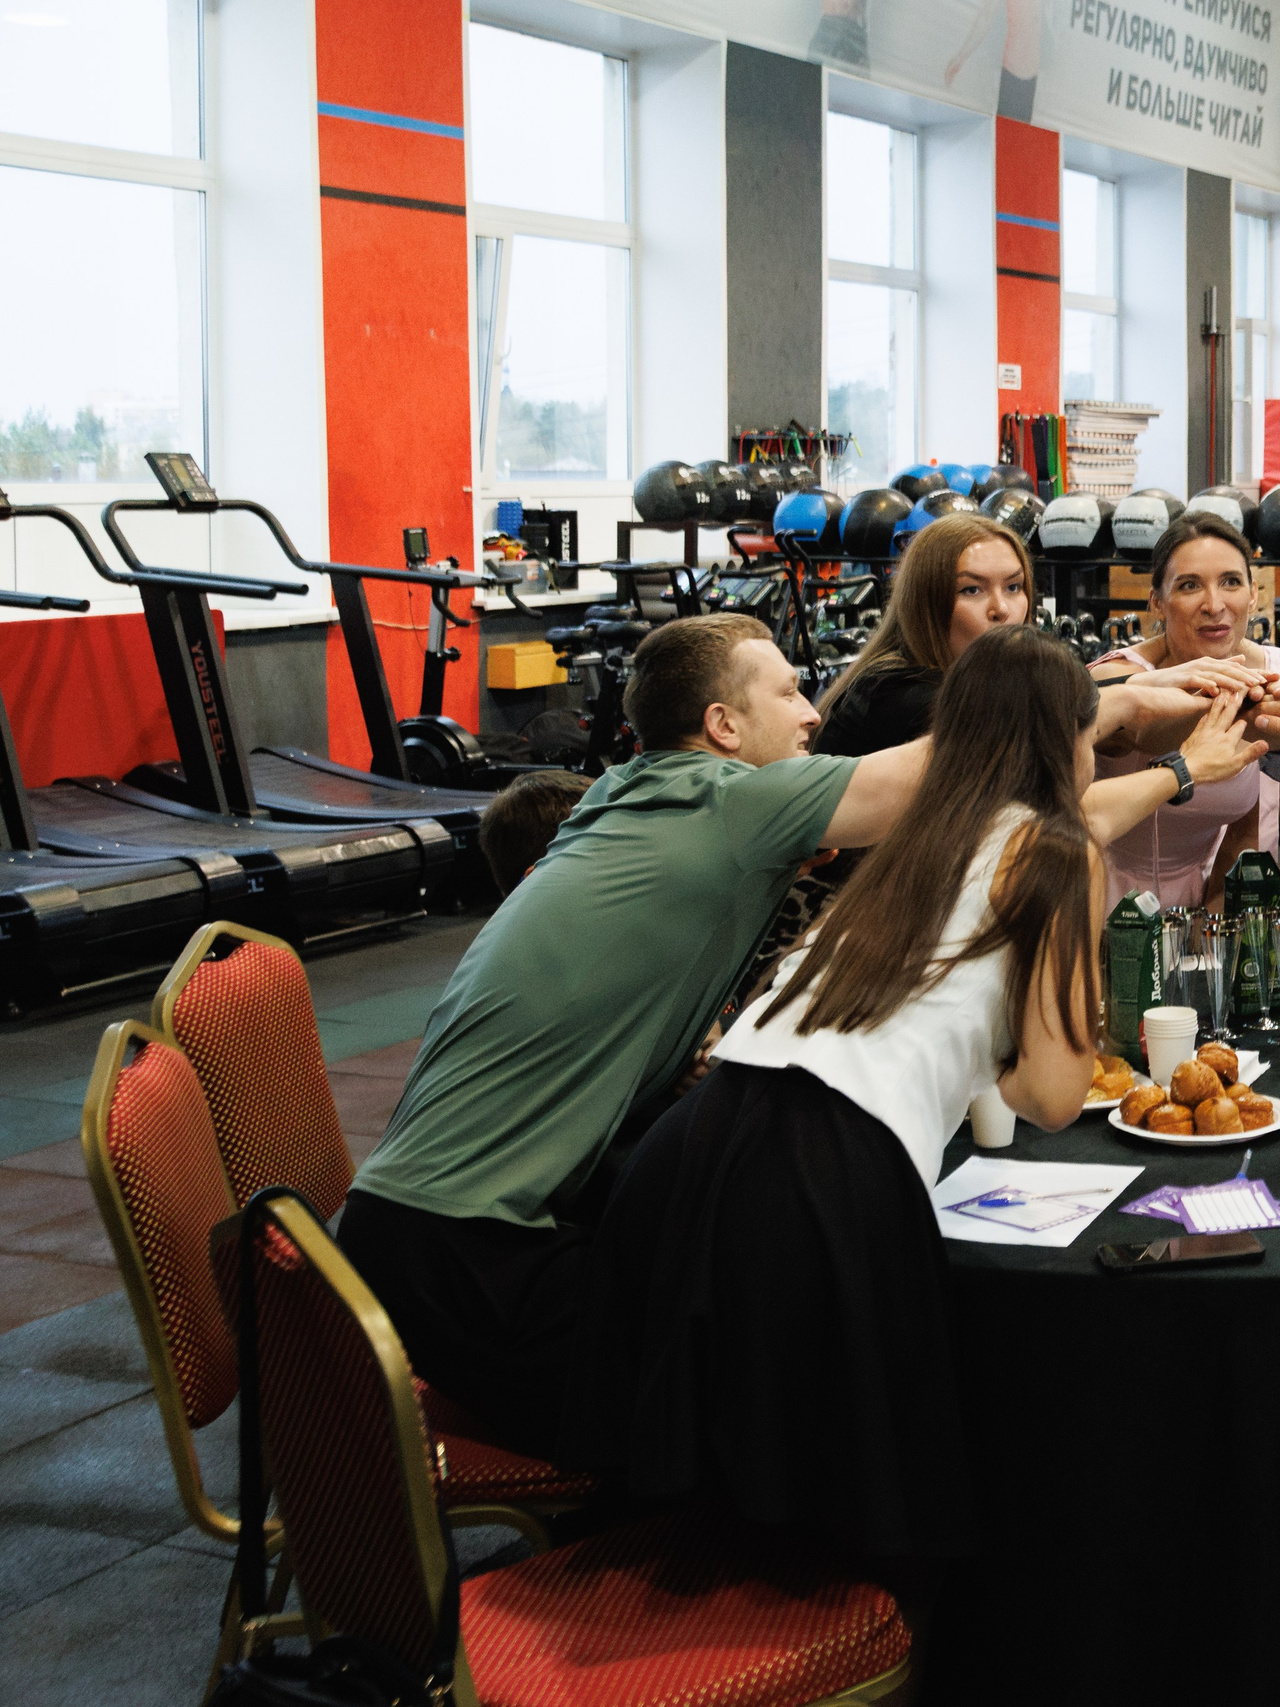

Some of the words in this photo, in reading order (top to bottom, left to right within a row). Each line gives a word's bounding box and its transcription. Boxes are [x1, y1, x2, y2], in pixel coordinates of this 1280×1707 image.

[1183, 34, 1268, 95] ВДУМЧИВО
[1107, 67, 1122, 106] И
[1125, 73, 1206, 131] БОЛЬШЕ
[1208, 100, 1264, 148] ЧИТАЙ
